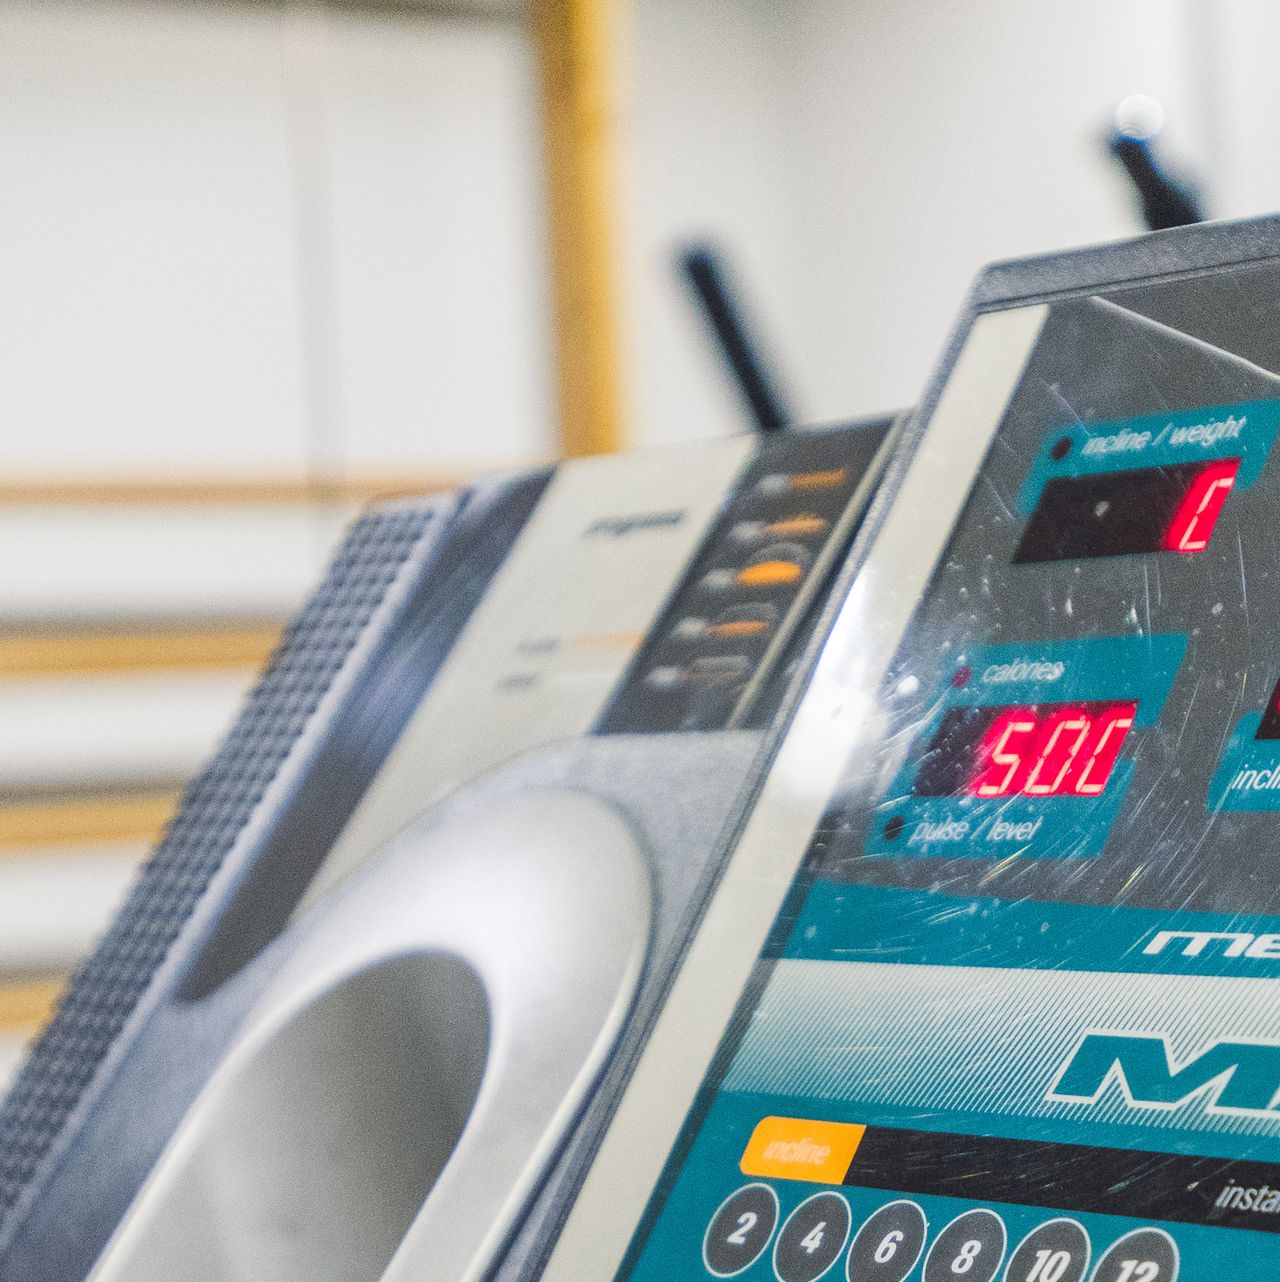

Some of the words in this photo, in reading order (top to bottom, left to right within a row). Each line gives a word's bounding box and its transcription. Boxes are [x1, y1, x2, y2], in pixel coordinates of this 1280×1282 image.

[1081, 430, 1152, 456] incline
[1170, 414, 1248, 446] weight
[981, 660, 1064, 684] calories
[909, 818, 970, 846] pulse
[985, 816, 1042, 841] level
[727, 1212, 758, 1244] 2
[801, 1221, 827, 1254] 4
[874, 1231, 903, 1264] 6
[951, 1240, 982, 1274] 8
